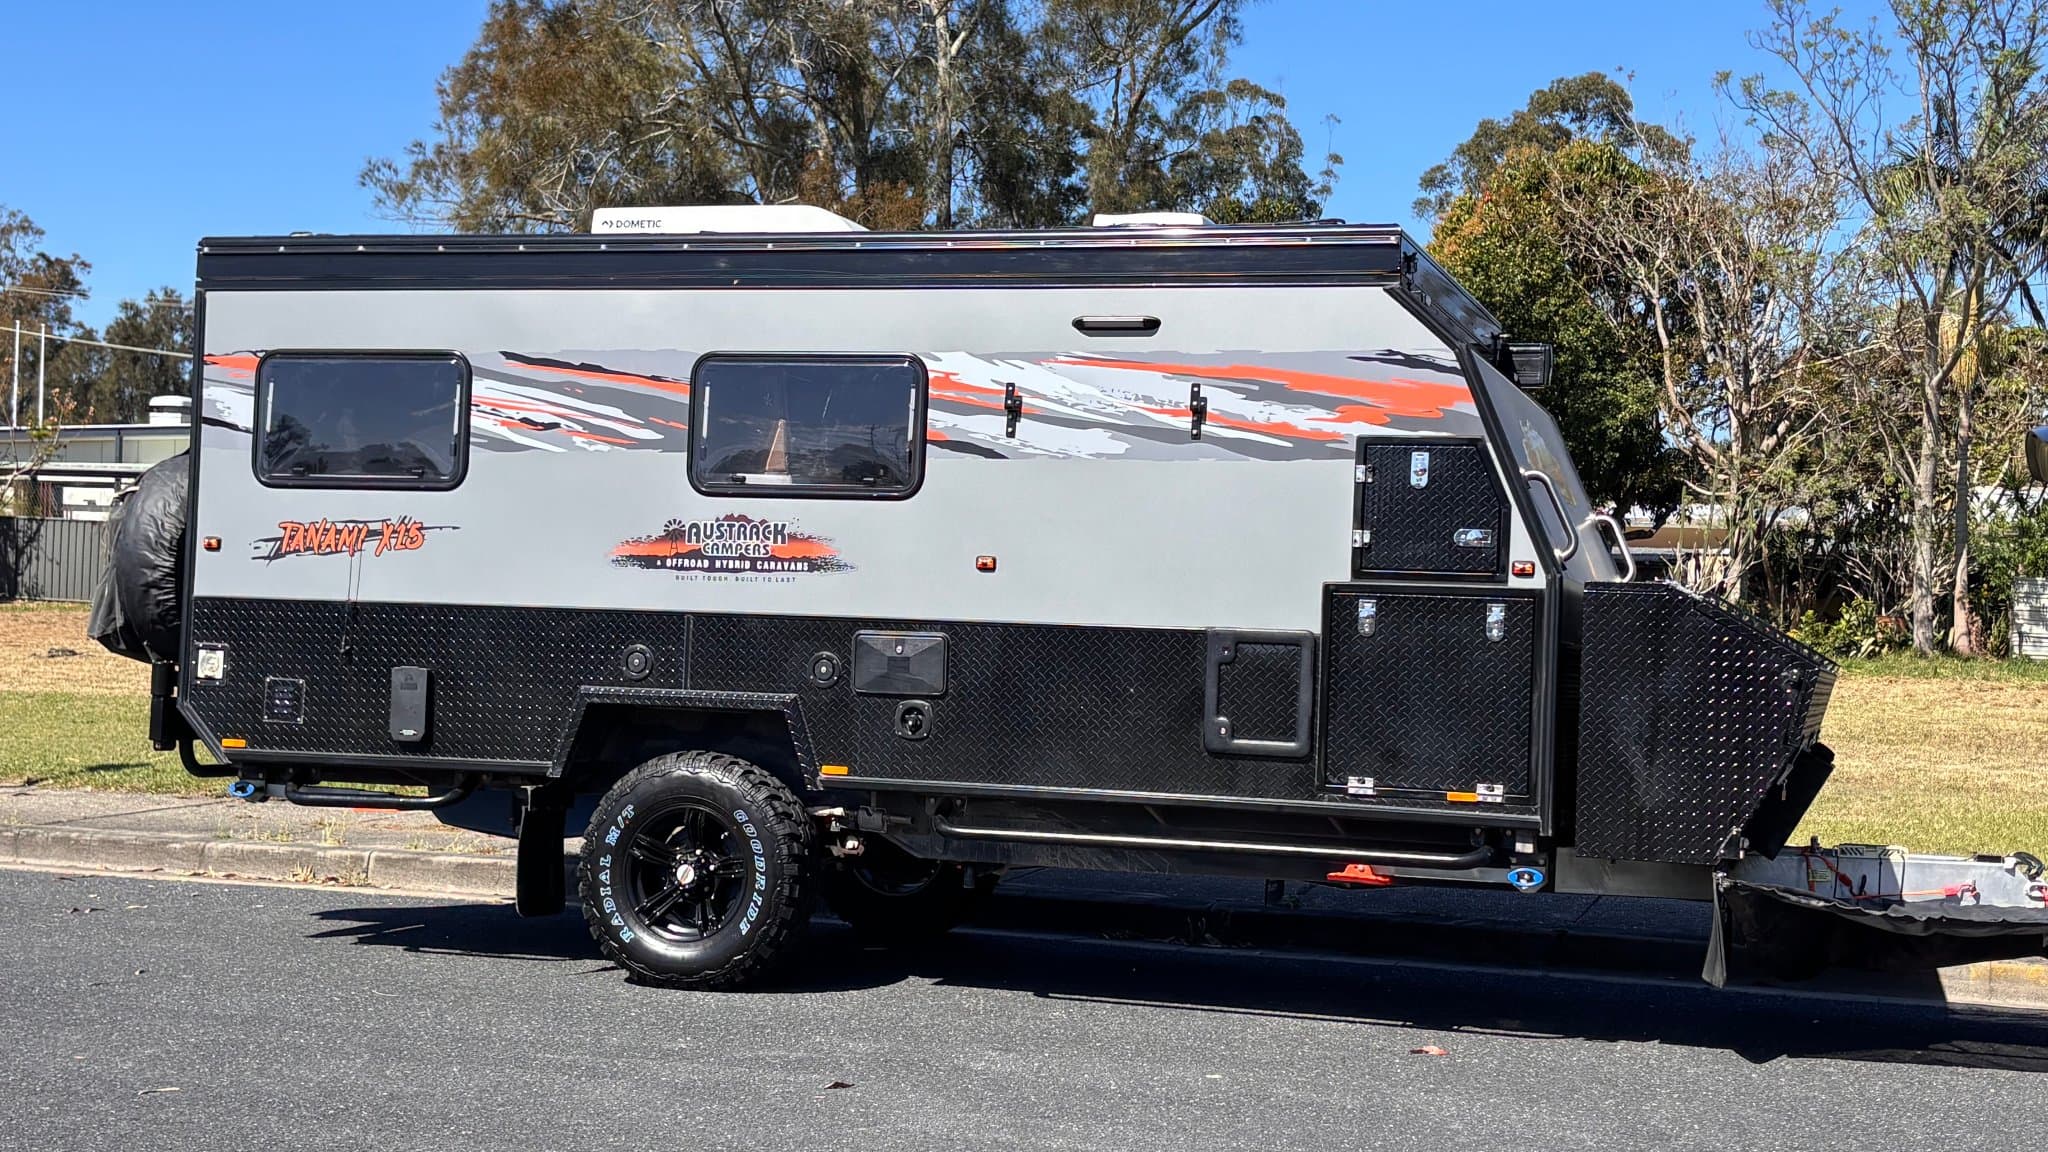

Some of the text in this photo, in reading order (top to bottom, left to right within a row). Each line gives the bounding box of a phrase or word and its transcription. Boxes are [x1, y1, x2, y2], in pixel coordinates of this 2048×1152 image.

[616, 219, 662, 229] DOMETIC
[278, 518, 369, 557] TANAMI
[686, 521, 789, 545] AUSTRACK
[701, 541, 772, 556] CAMPERS
[666, 558, 709, 569] OFFROAD
[715, 560, 751, 570] HYBRID
[756, 560, 809, 571] CARAVANS
[599, 804, 635, 943] RADIAL M/T
[733, 809, 766, 936] GOODRIDE
